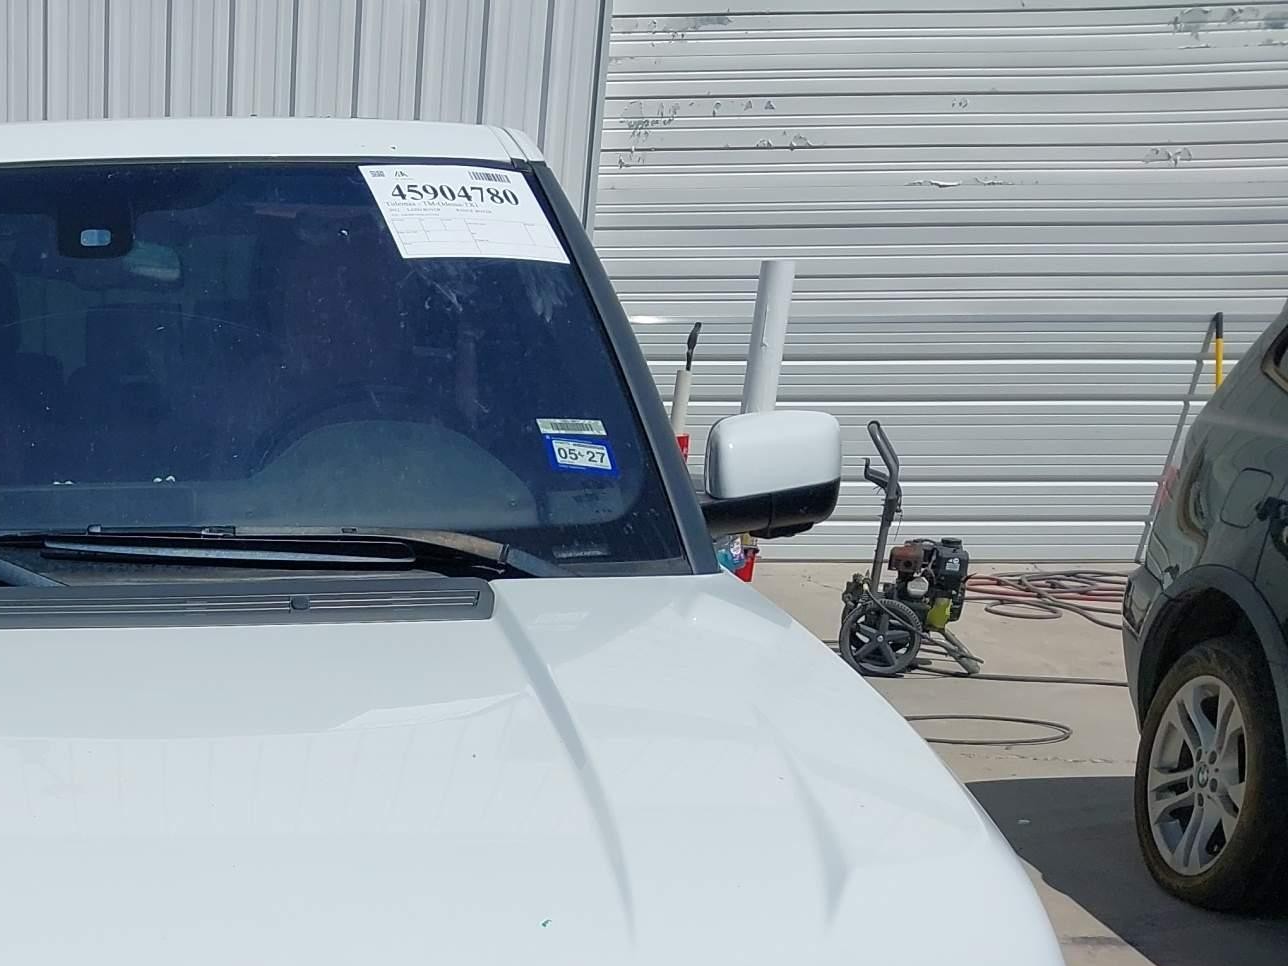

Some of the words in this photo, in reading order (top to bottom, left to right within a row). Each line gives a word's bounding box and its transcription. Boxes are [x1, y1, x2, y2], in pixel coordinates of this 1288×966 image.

[391, 183, 520, 206] 45904780
[557, 447, 578, 461] 05
[586, 450, 606, 463] 27
